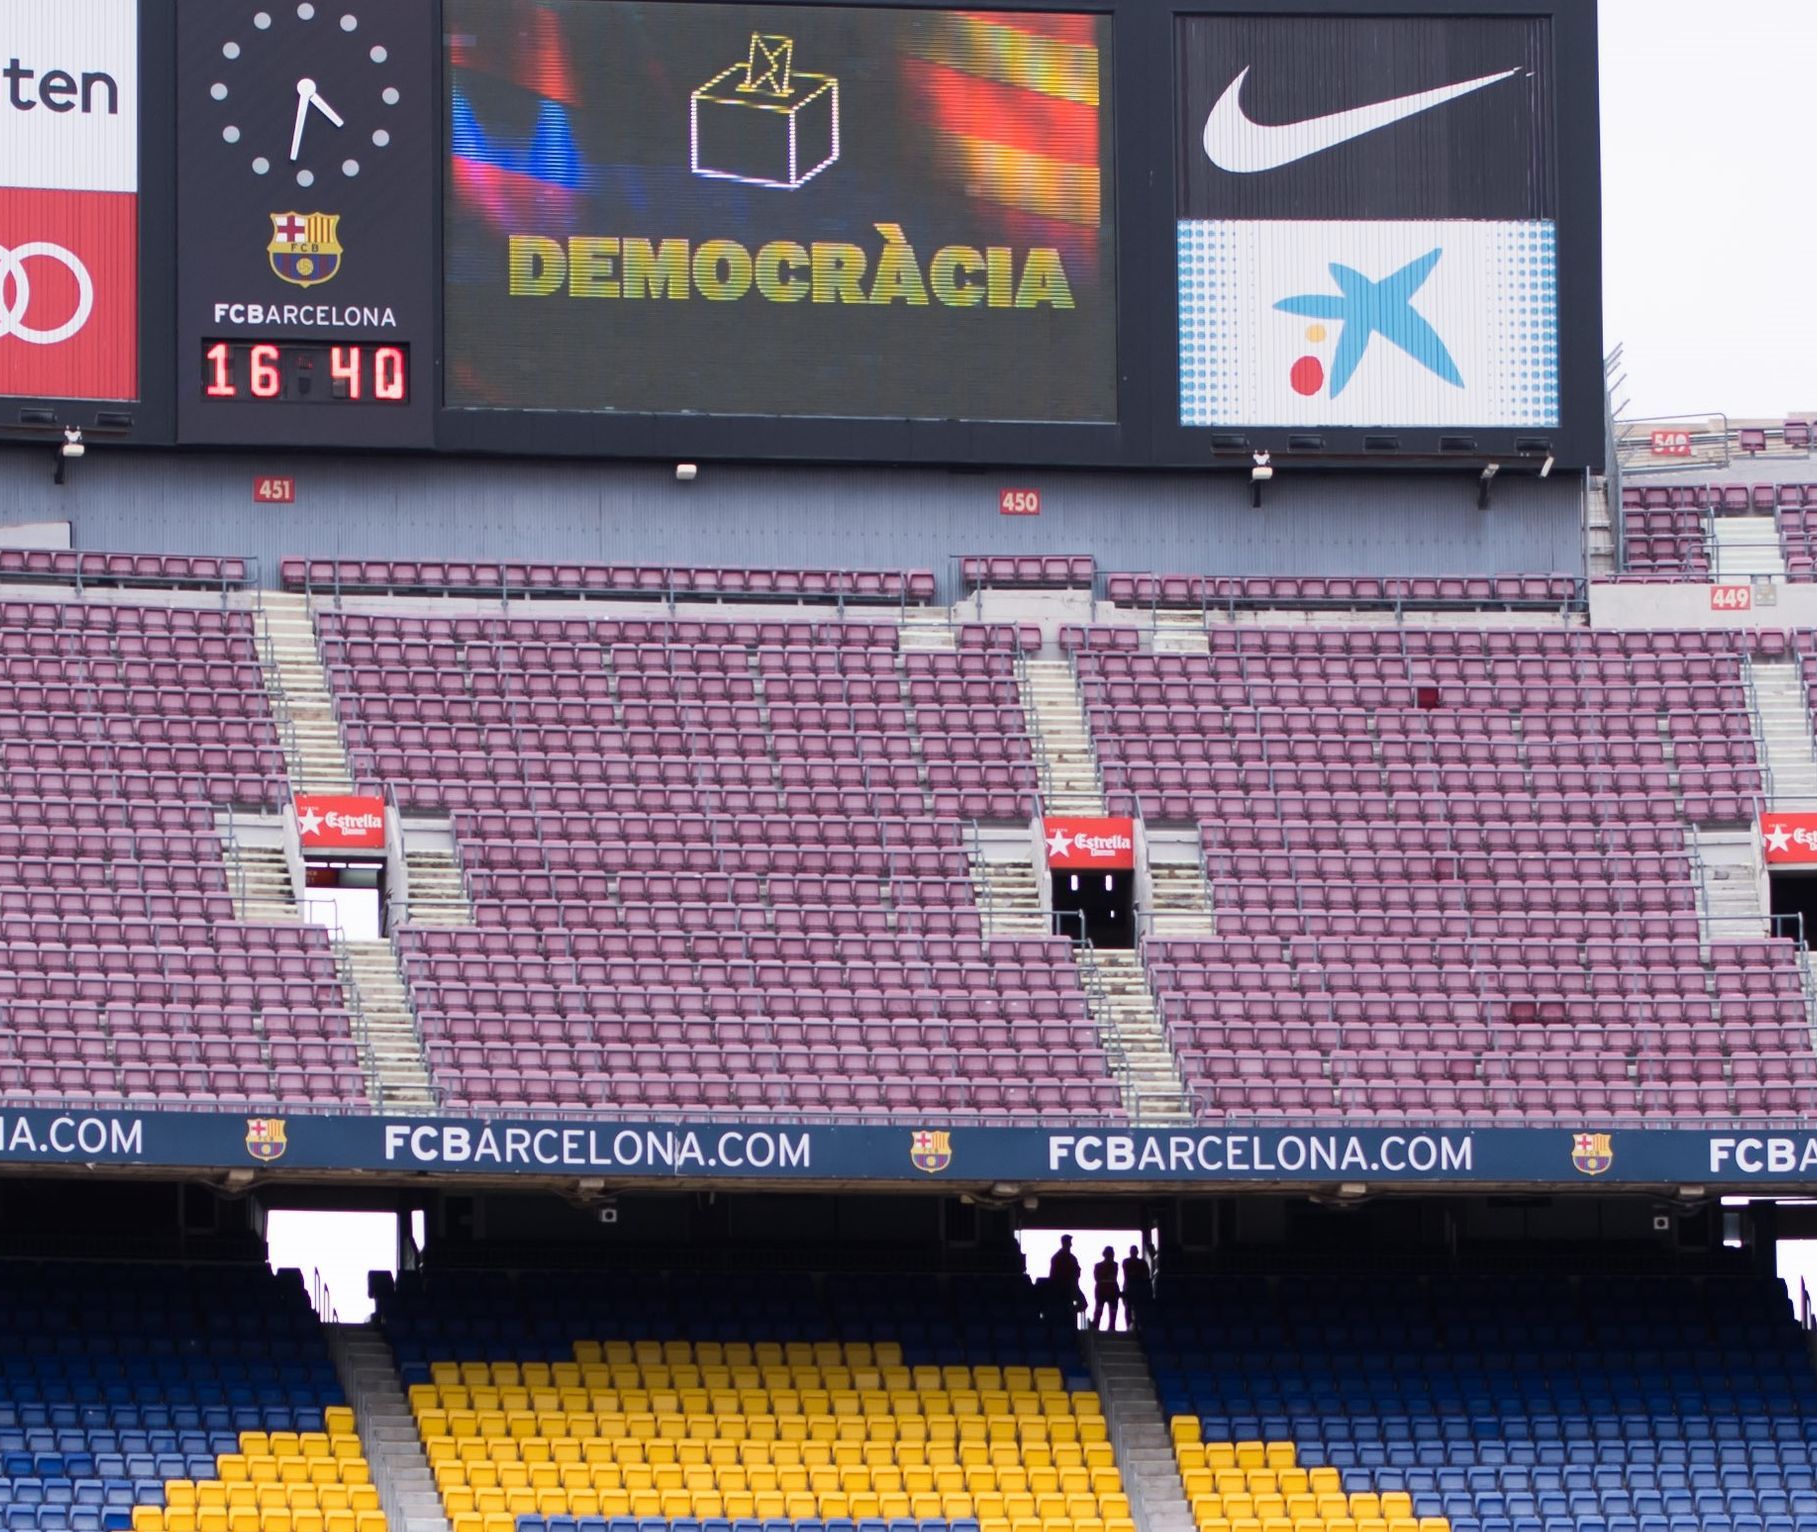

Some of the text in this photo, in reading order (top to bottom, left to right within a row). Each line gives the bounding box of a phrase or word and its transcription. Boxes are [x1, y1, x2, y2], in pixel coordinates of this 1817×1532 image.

[509, 223, 1075, 308] DEMOCRÀCIA
[215, 304, 396, 326] FCBARCELONA
[207, 343, 279, 396] 16
[259, 480, 290, 499] 451
[1002, 492, 1038, 511] 450
[1713, 589, 1748, 607] 449
[325, 812, 382, 829] Estrella
[1074, 833, 1131, 850] Estrella
[385, 1126, 810, 1167] FCBARCELONA.COM
[1049, 1136, 1472, 1171] FCBARCELONA.COM
